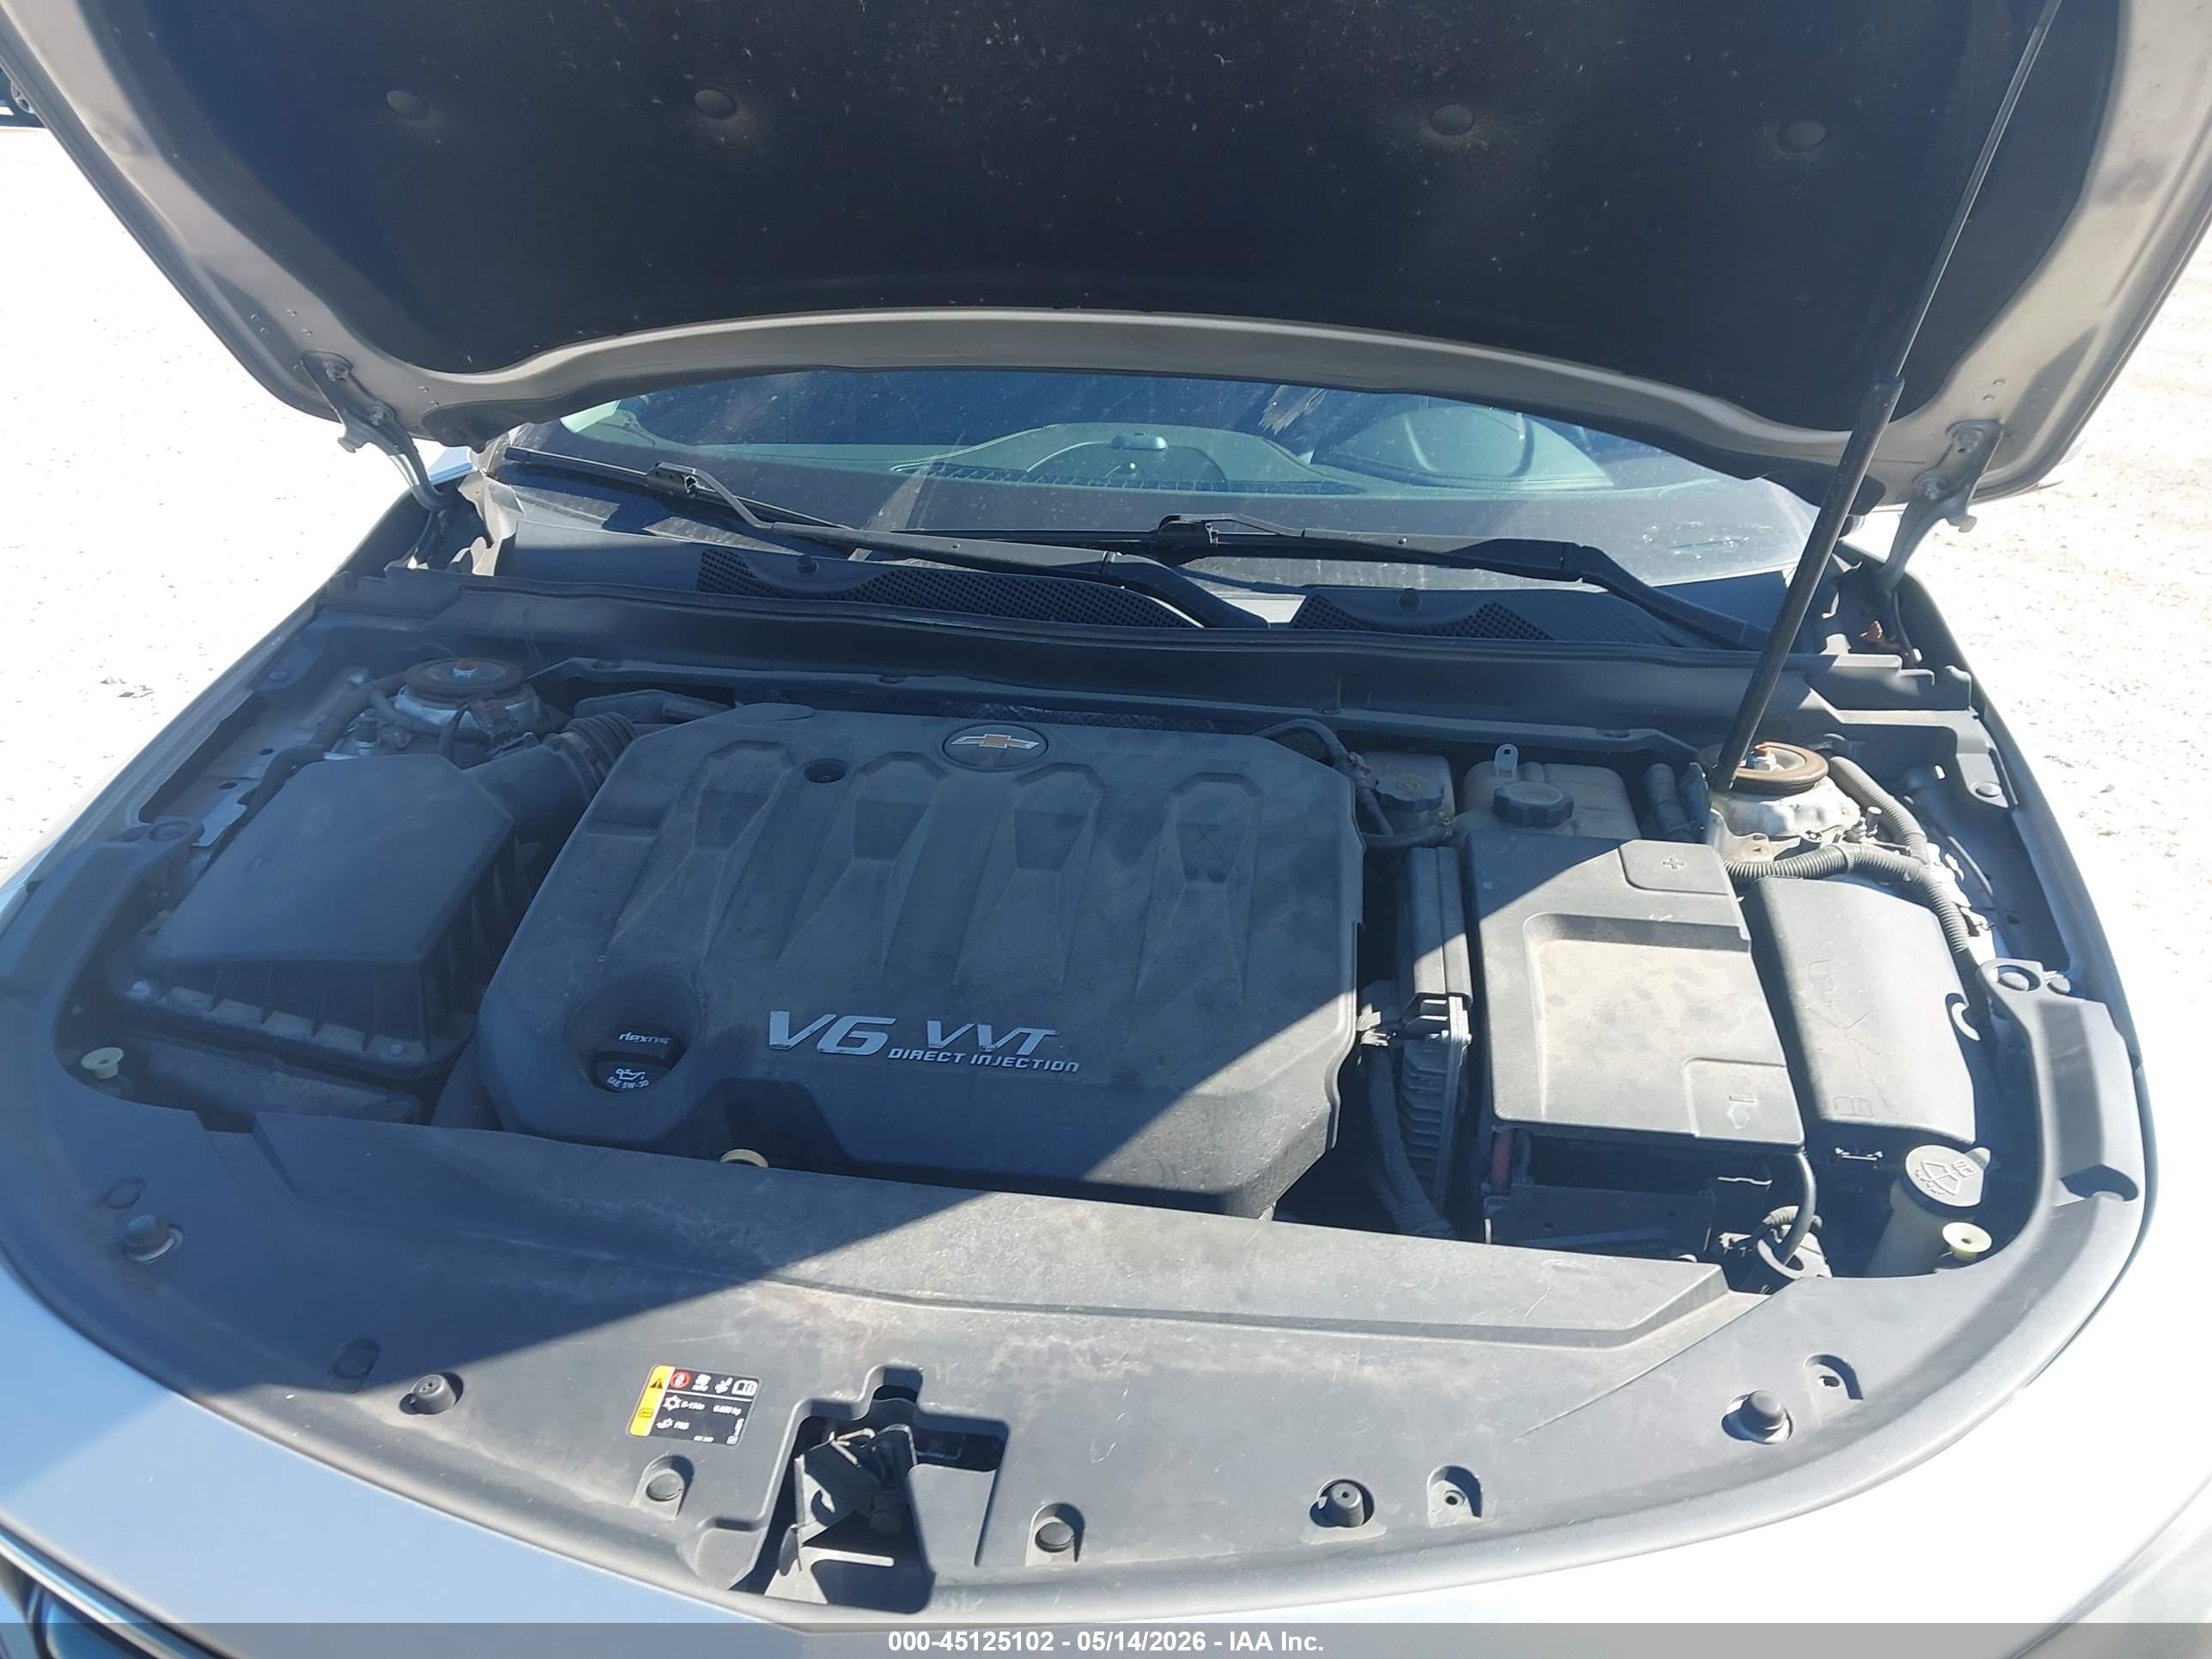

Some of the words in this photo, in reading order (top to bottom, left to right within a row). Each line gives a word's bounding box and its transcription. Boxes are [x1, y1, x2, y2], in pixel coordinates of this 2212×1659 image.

[769, 1010, 896, 1056] V6
[926, 1020, 1059, 1055] VVT
[888, 1048, 966, 1065] DIRECT
[969, 1054, 1080, 1073] INJECTION
